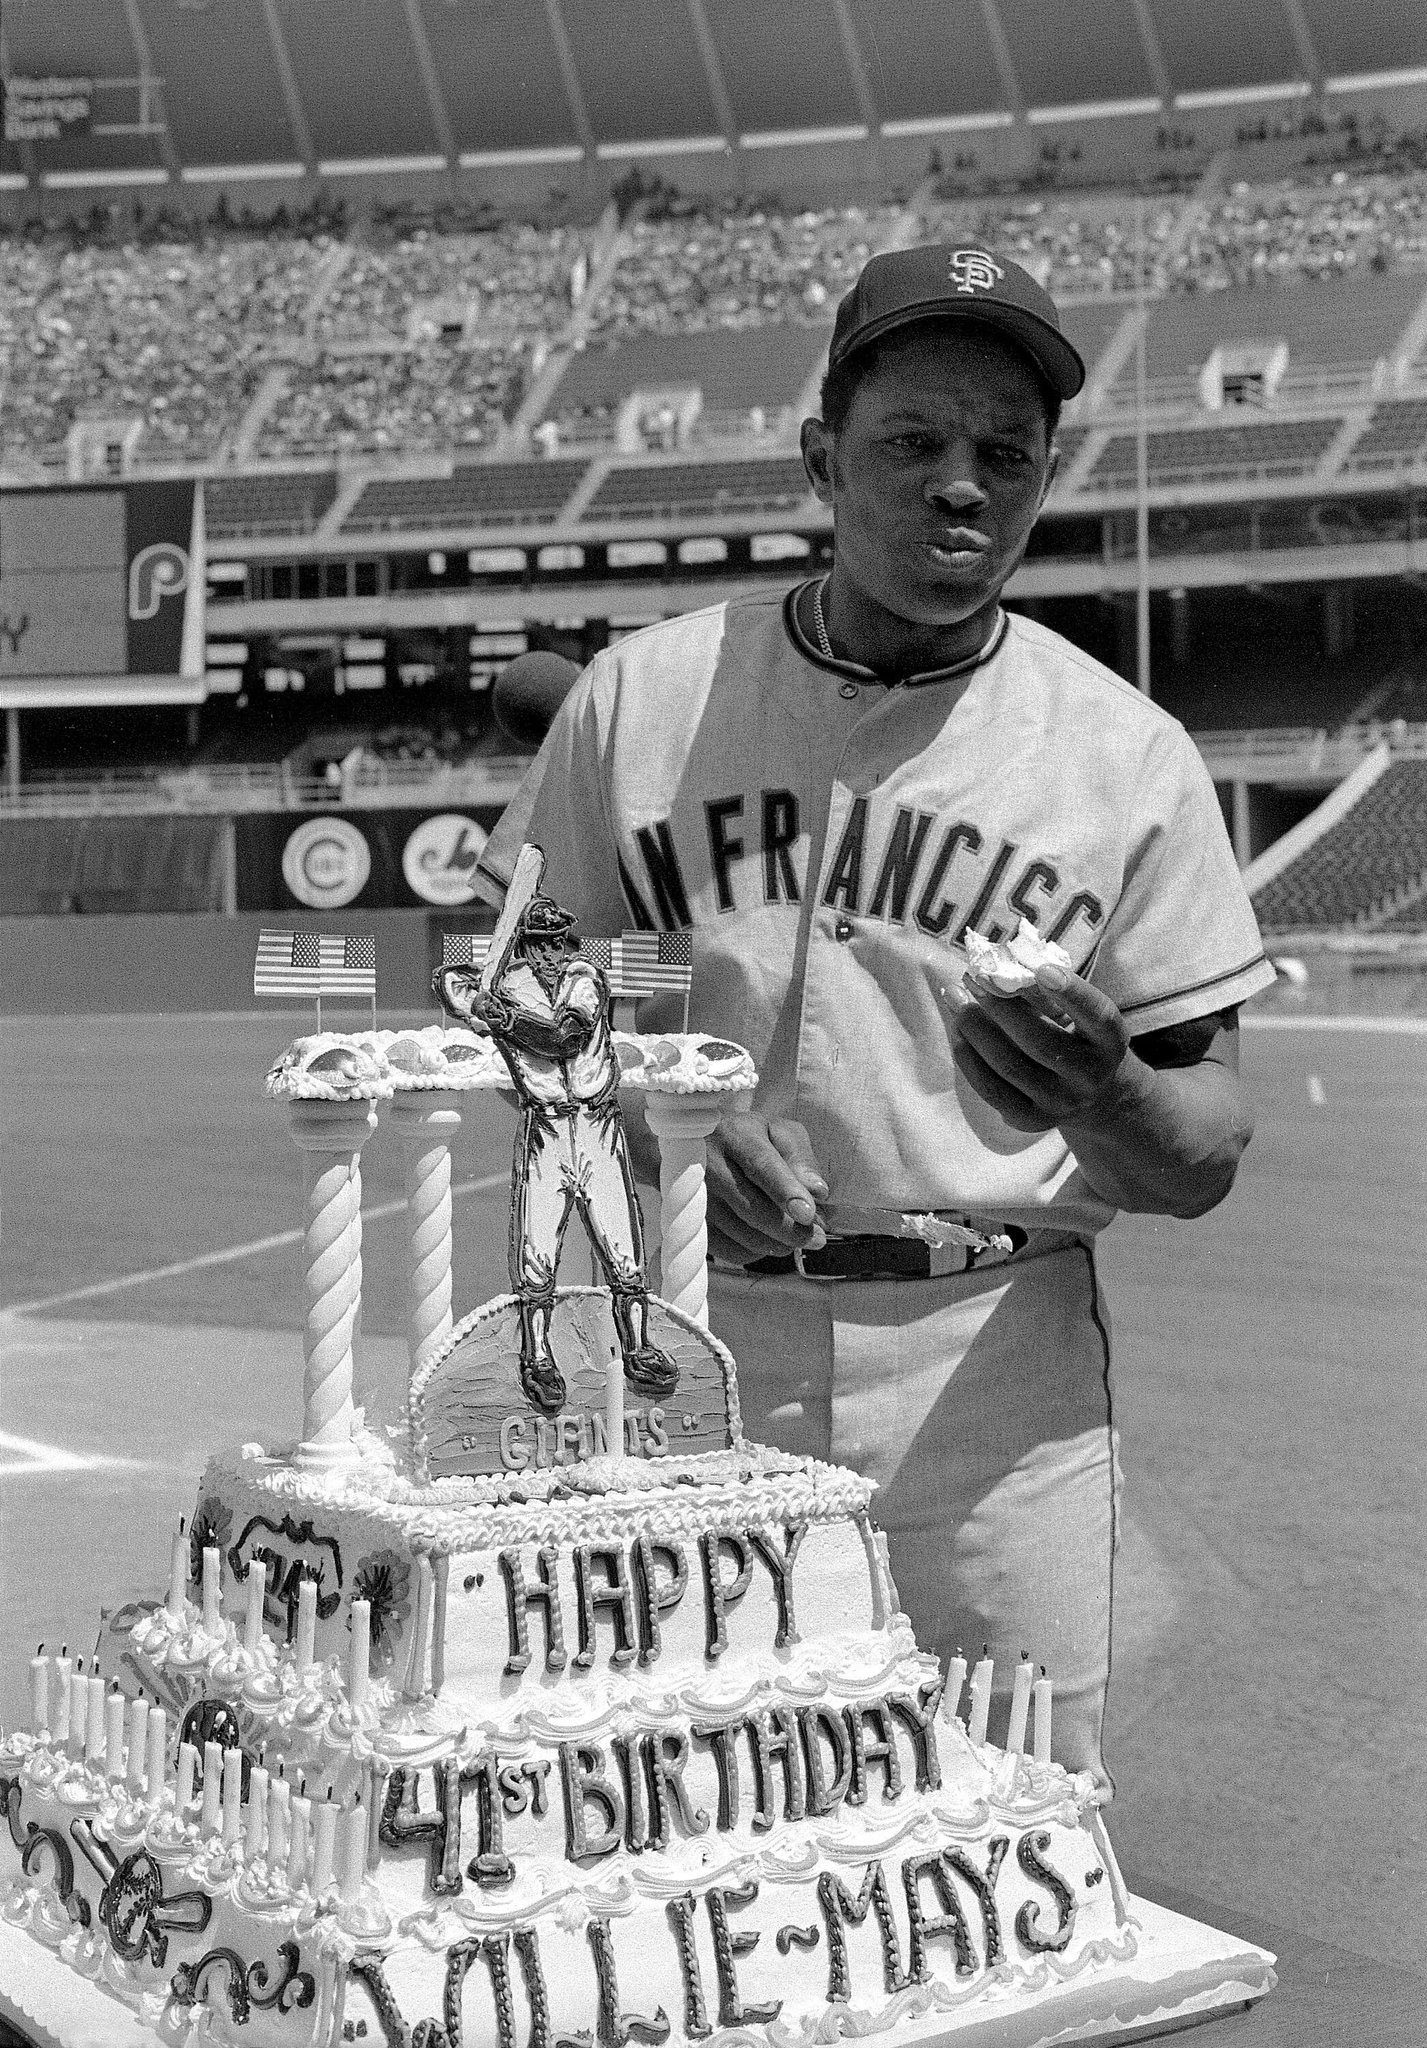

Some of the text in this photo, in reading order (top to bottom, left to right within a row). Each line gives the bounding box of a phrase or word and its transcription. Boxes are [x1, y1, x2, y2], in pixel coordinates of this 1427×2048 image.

[949, 249, 1005, 294] SF
[128, 542, 191, 621] P
[703, 787, 1106, 962] FRANCISC
[499, 1406, 669, 1470] GIANTS
[498, 1522, 809, 1676] HAPPY
[558, 1674, 943, 1862] BIRTHDAY
